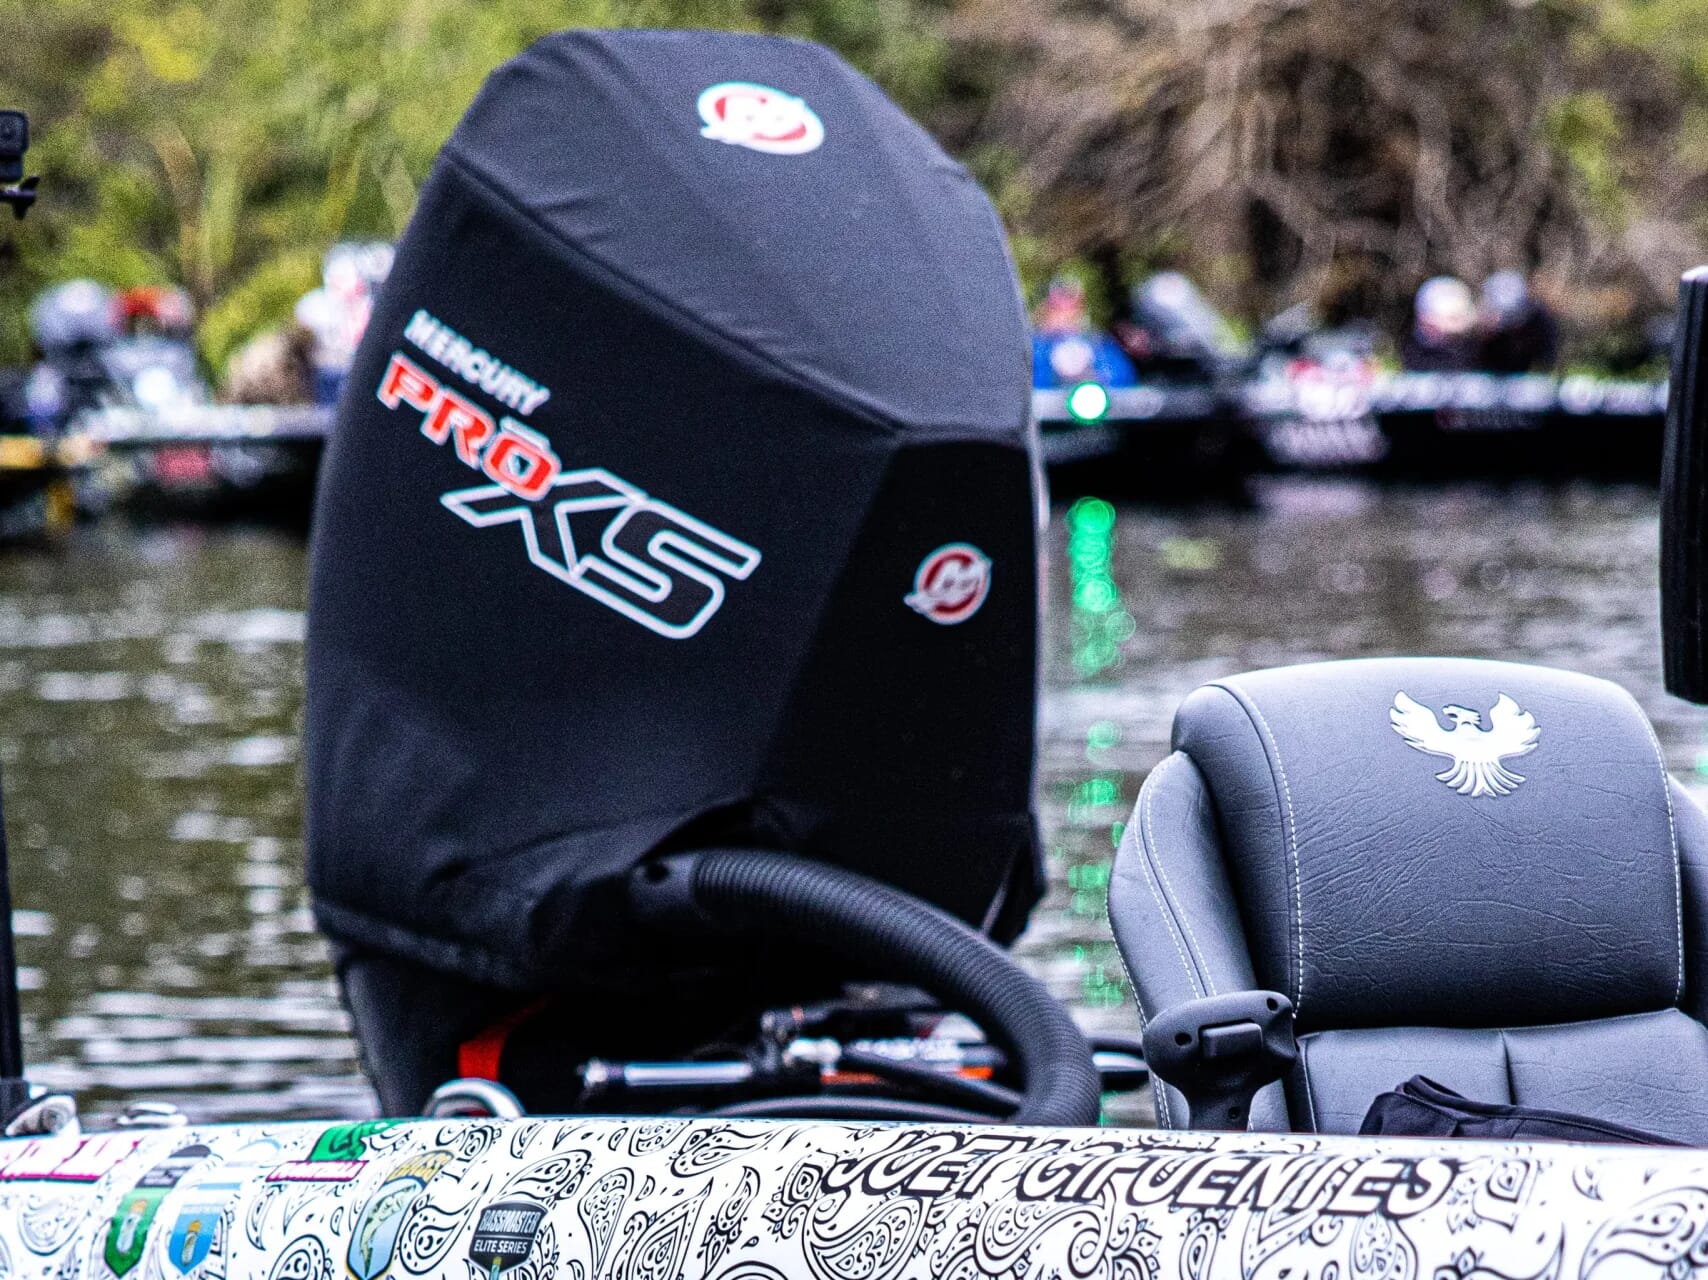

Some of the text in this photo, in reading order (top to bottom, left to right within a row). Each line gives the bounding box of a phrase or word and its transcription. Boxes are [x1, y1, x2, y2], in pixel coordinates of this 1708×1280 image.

[404, 309, 550, 416] MERCURY
[479, 1210, 542, 1233] BASSMASTER
[473, 1239, 528, 1254] ELITE SERIES
